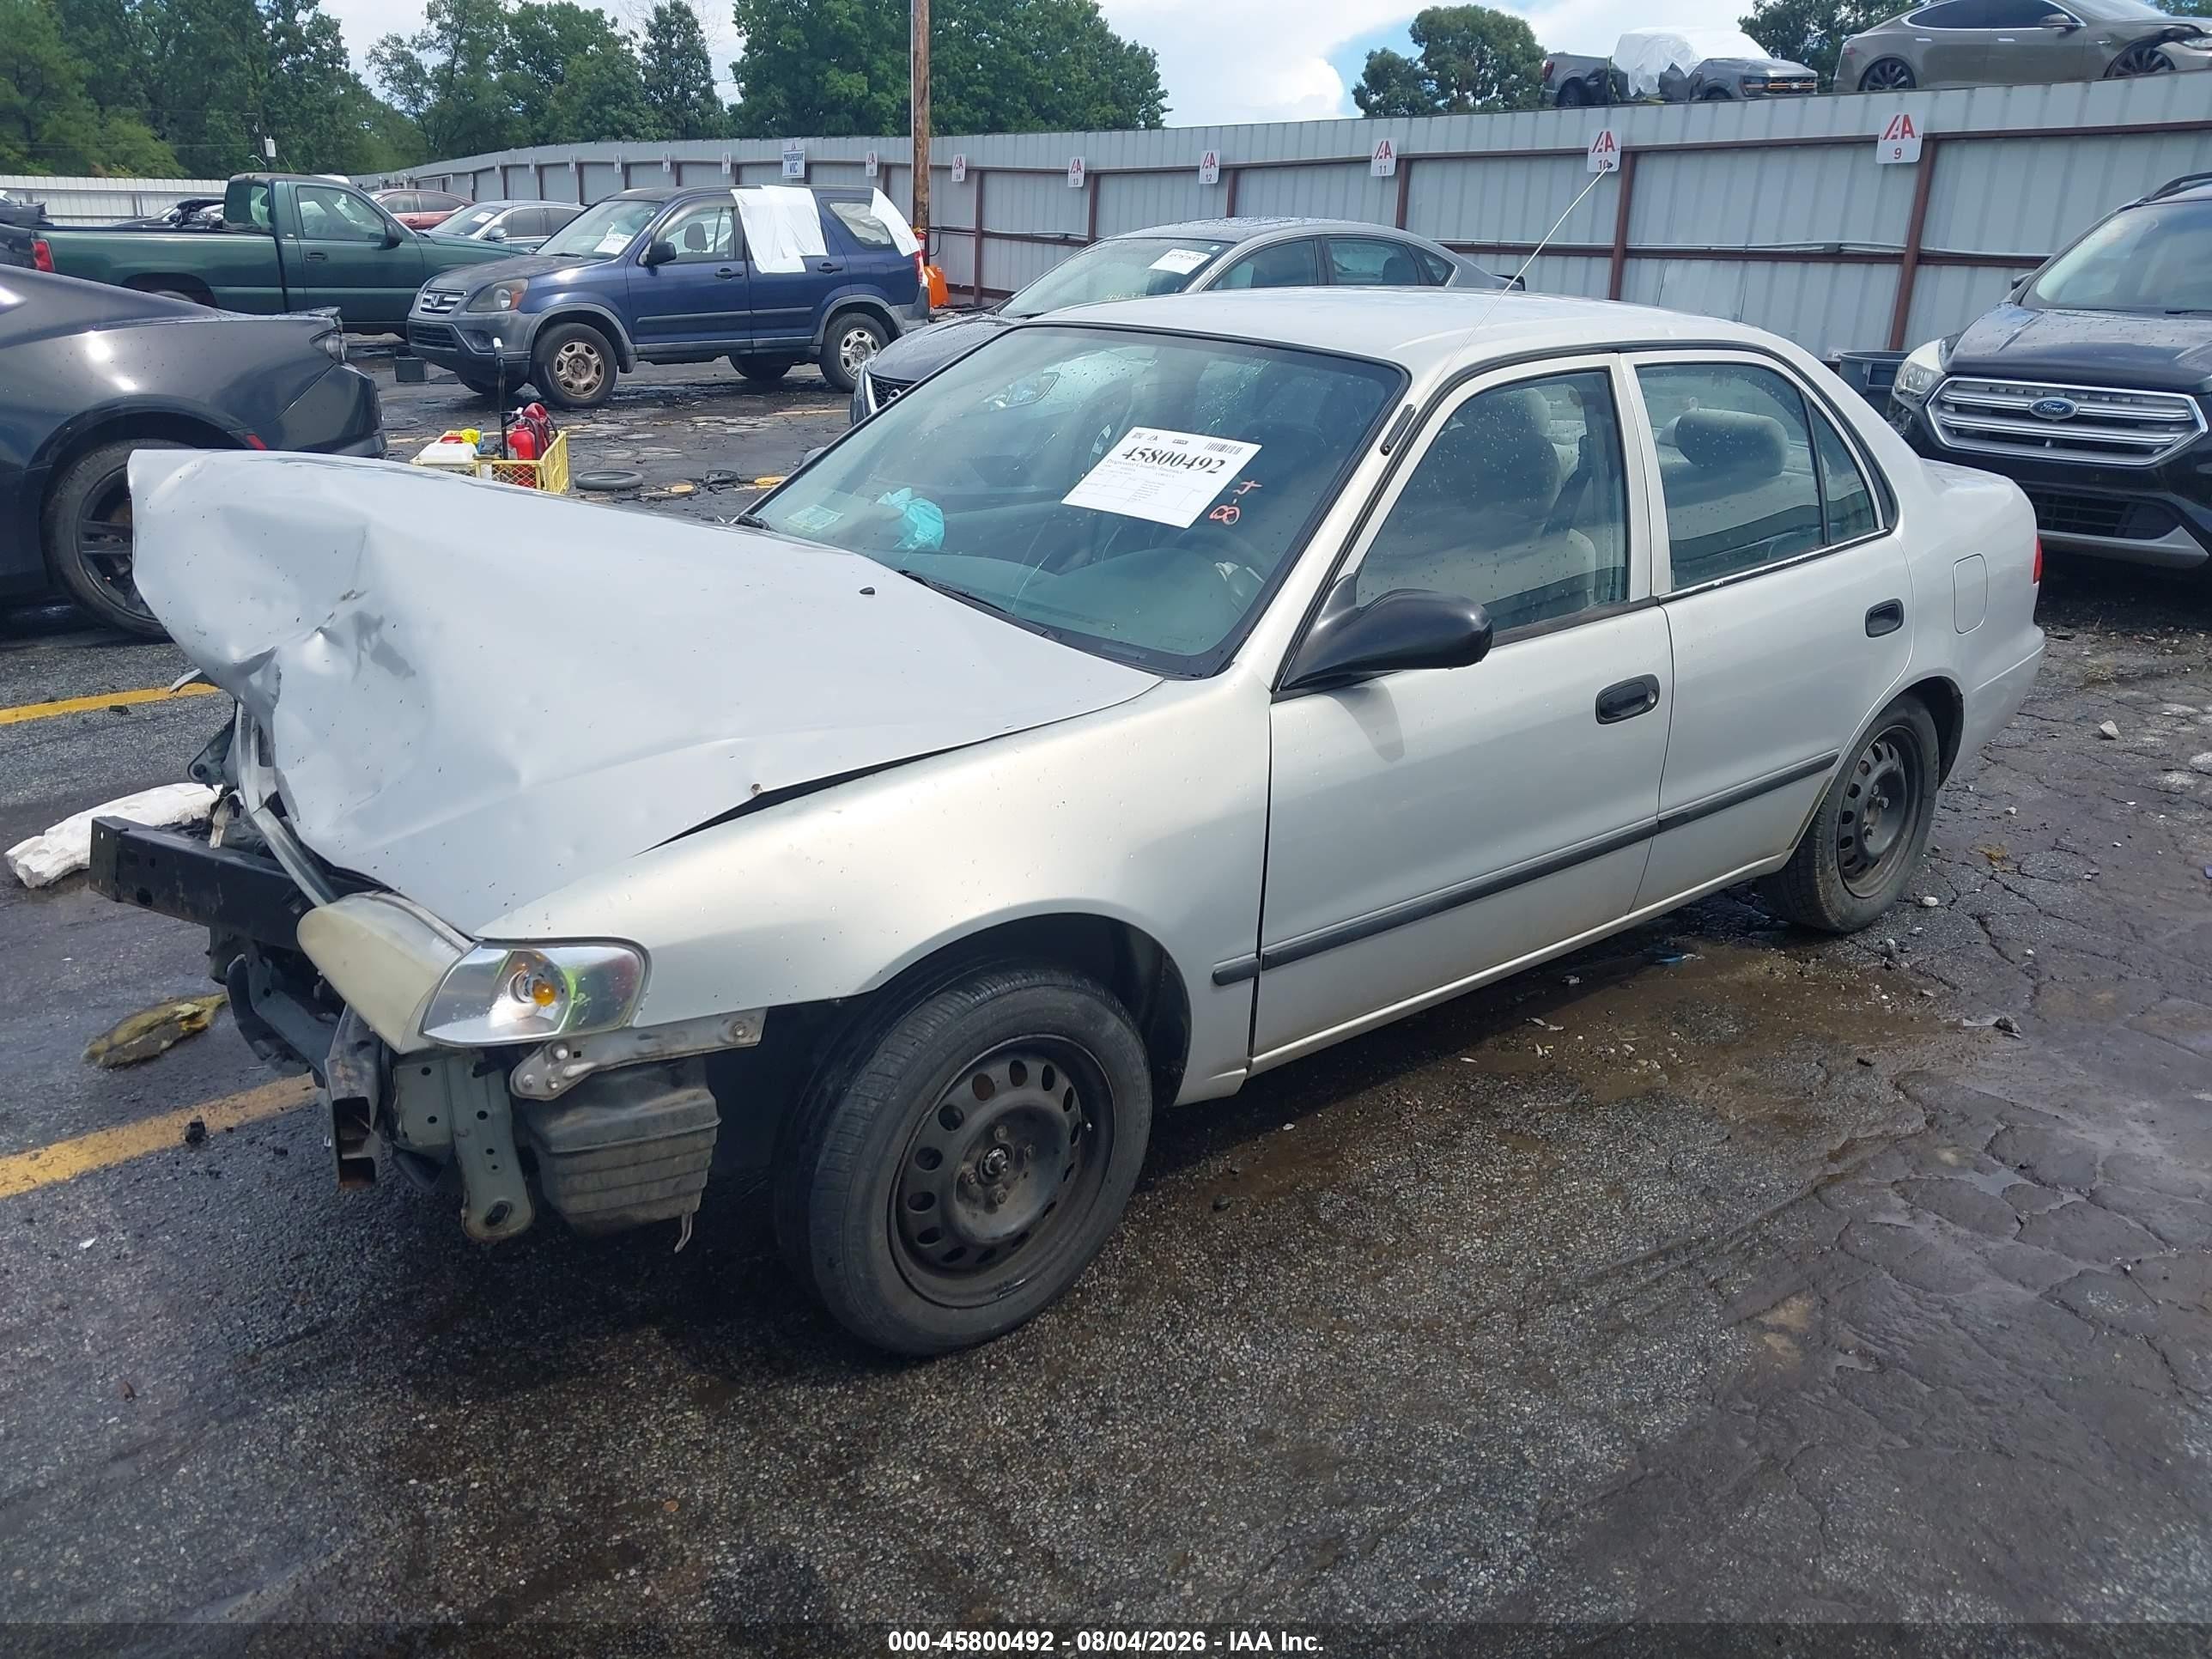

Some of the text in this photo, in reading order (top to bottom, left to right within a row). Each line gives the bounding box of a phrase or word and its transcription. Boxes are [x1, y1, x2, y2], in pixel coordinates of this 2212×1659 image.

[1893, 147, 1902, 160] 9
[1378, 164, 1387, 174] 11
[1598, 159, 1609, 170] 10
[1206, 173, 1212, 182] 12
[2040, 402, 2065, 413] Ford
[1121, 446, 1226, 474] 45800492
